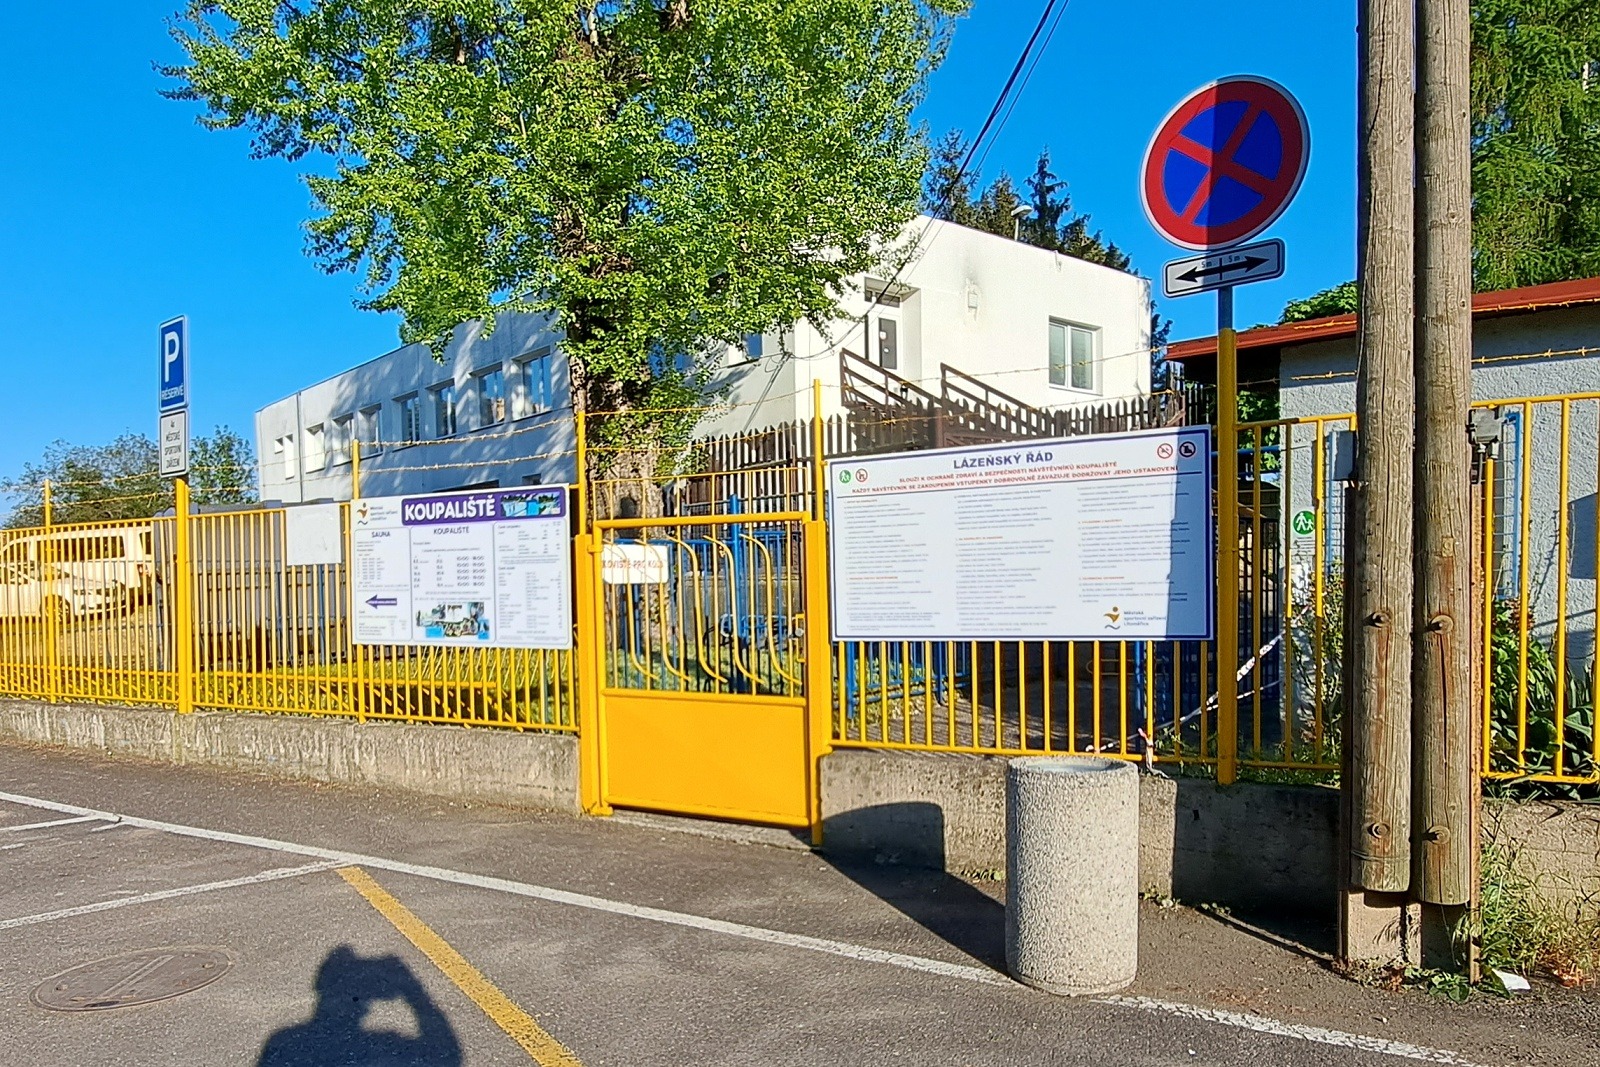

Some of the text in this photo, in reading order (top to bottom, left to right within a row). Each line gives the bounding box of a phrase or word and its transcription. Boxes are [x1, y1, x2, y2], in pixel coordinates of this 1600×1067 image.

[164, 330, 180, 383] P
[953, 450, 1053, 469] LÁZEŇSKÝ ŘÁD
[1076, 461, 1118, 470] KOUPALIŠTĚ
[1113, 467, 1131, 475] JEHO
[404, 494, 496, 522] KOUPALIŠTĚ
